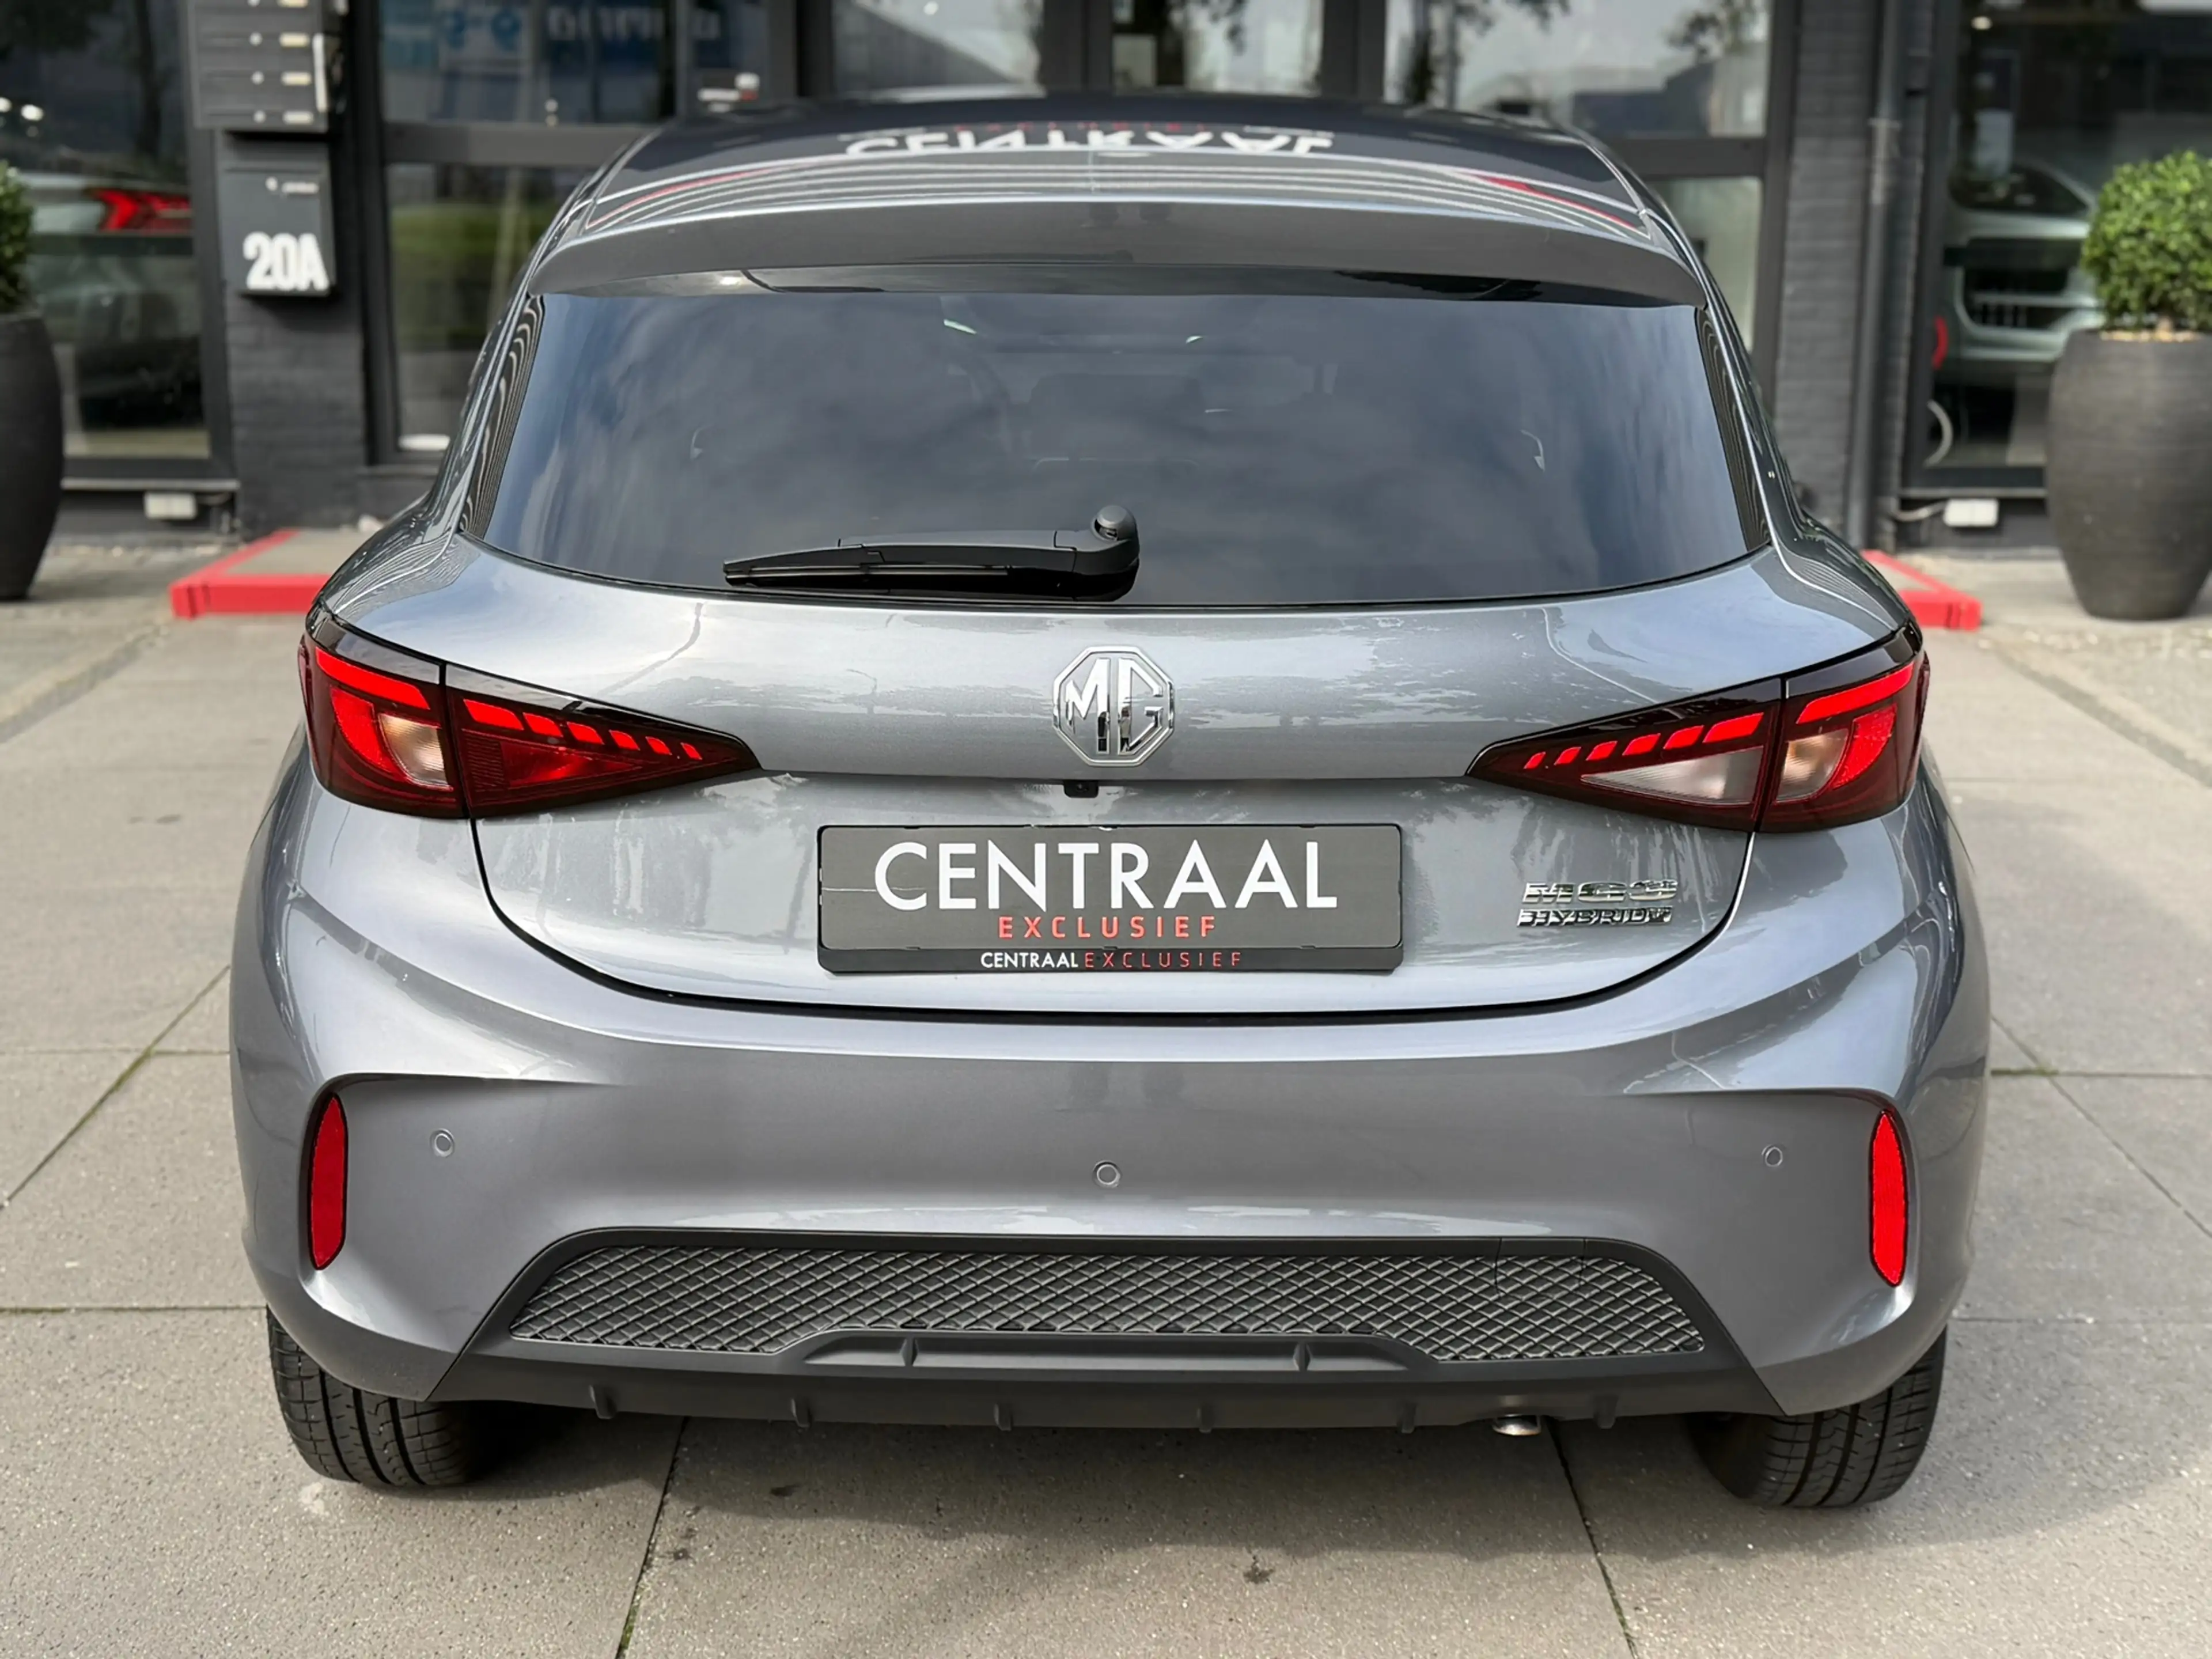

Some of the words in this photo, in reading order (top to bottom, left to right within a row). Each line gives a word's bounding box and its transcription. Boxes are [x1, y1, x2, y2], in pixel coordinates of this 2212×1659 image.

[243, 232, 329, 291] 20A
[1065, 657, 1164, 756] MG
[874, 839, 1338, 911] CENTRAAL
[998, 916, 1217, 940] EXCLUSIEF
[980, 952, 1079, 968] CENTRAAL
[1085, 952, 1241, 968] EXCLUSIEF
